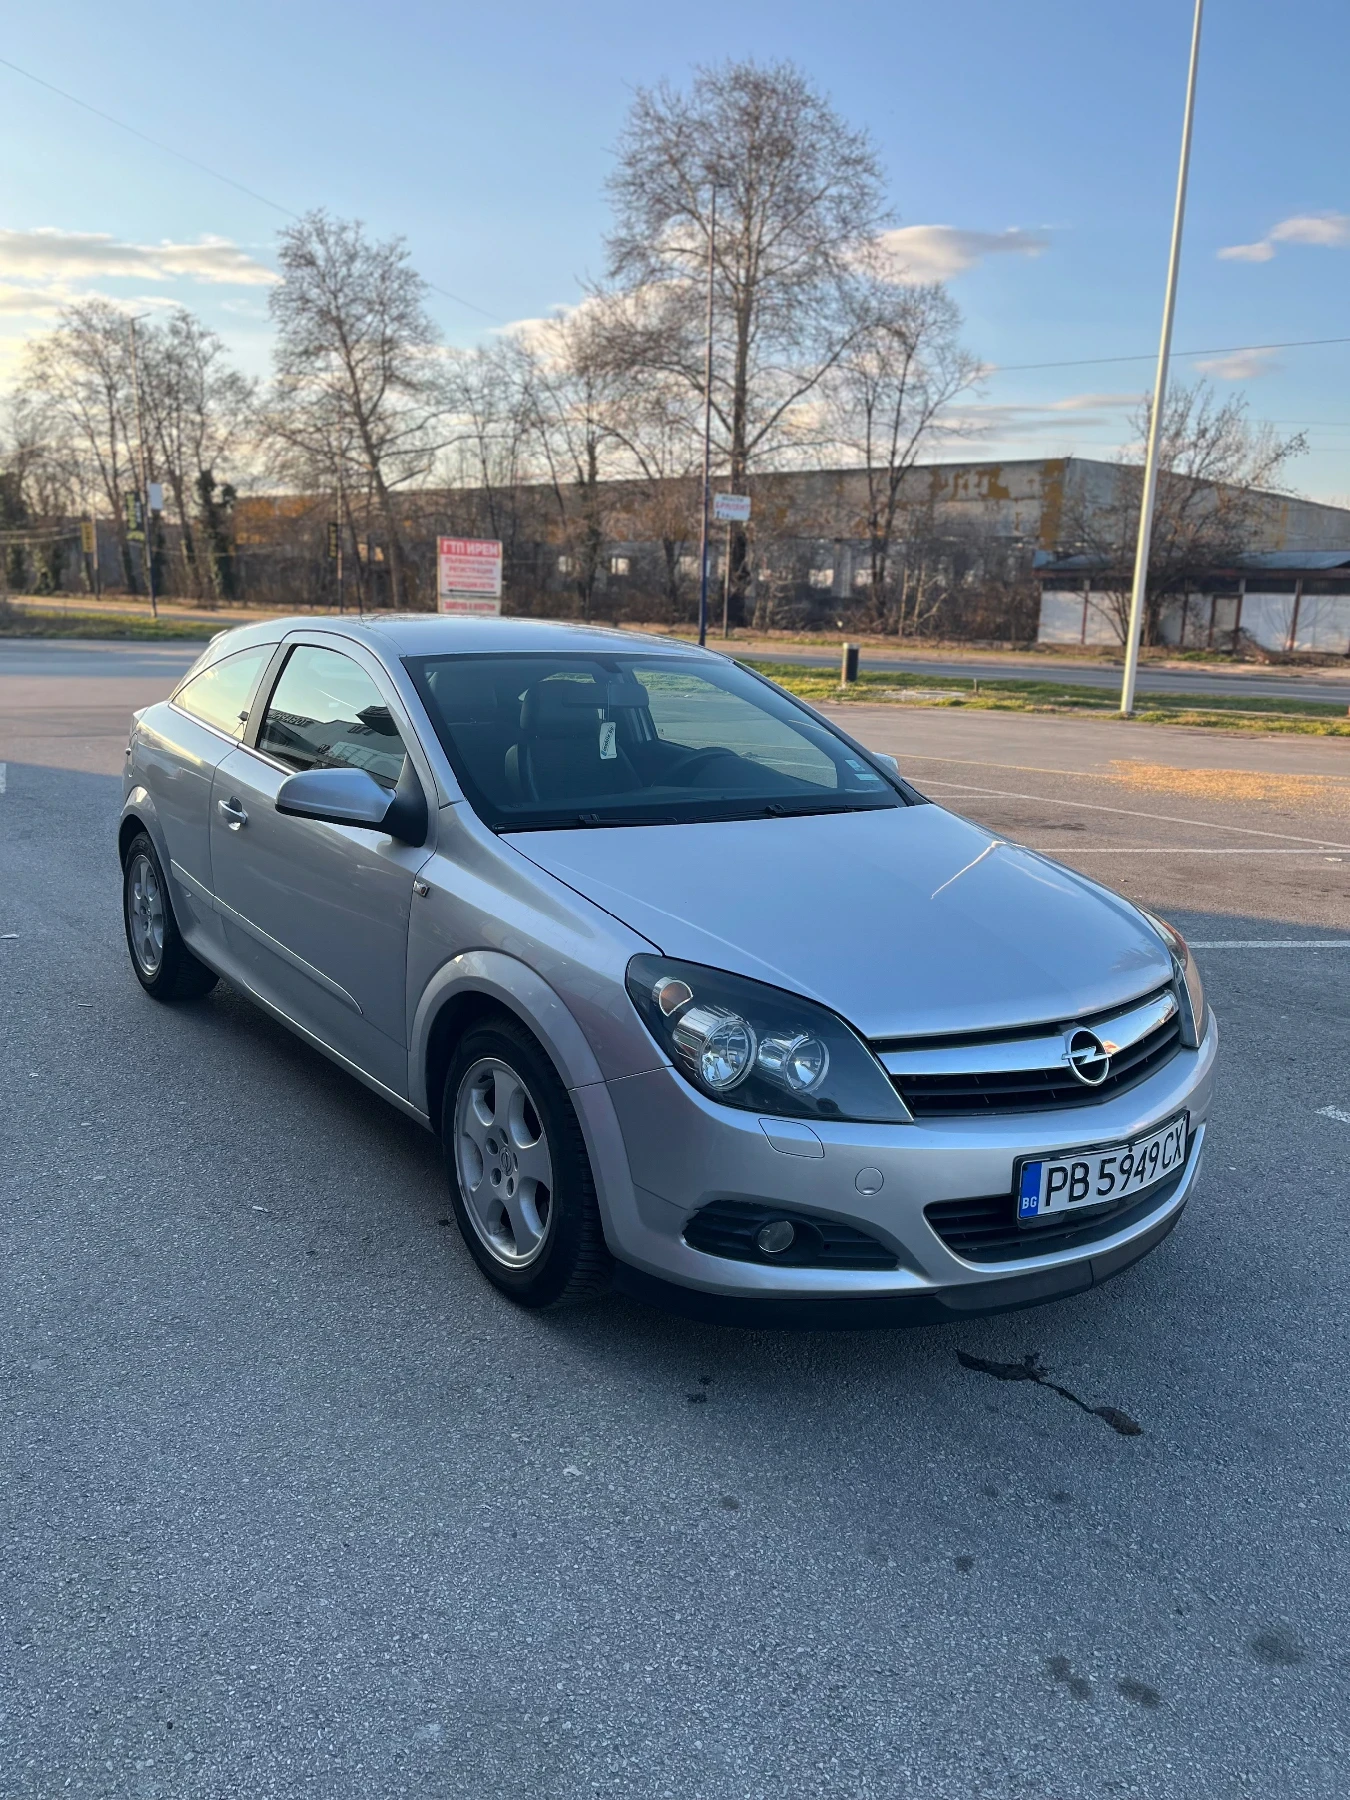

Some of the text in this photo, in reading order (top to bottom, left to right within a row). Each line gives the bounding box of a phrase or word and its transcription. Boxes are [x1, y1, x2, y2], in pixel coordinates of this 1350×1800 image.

[443, 541, 464, 554] ГТП
[1045, 1121, 1184, 1206] PB 5949 CX
[1021, 1195, 1038, 1210] BG
